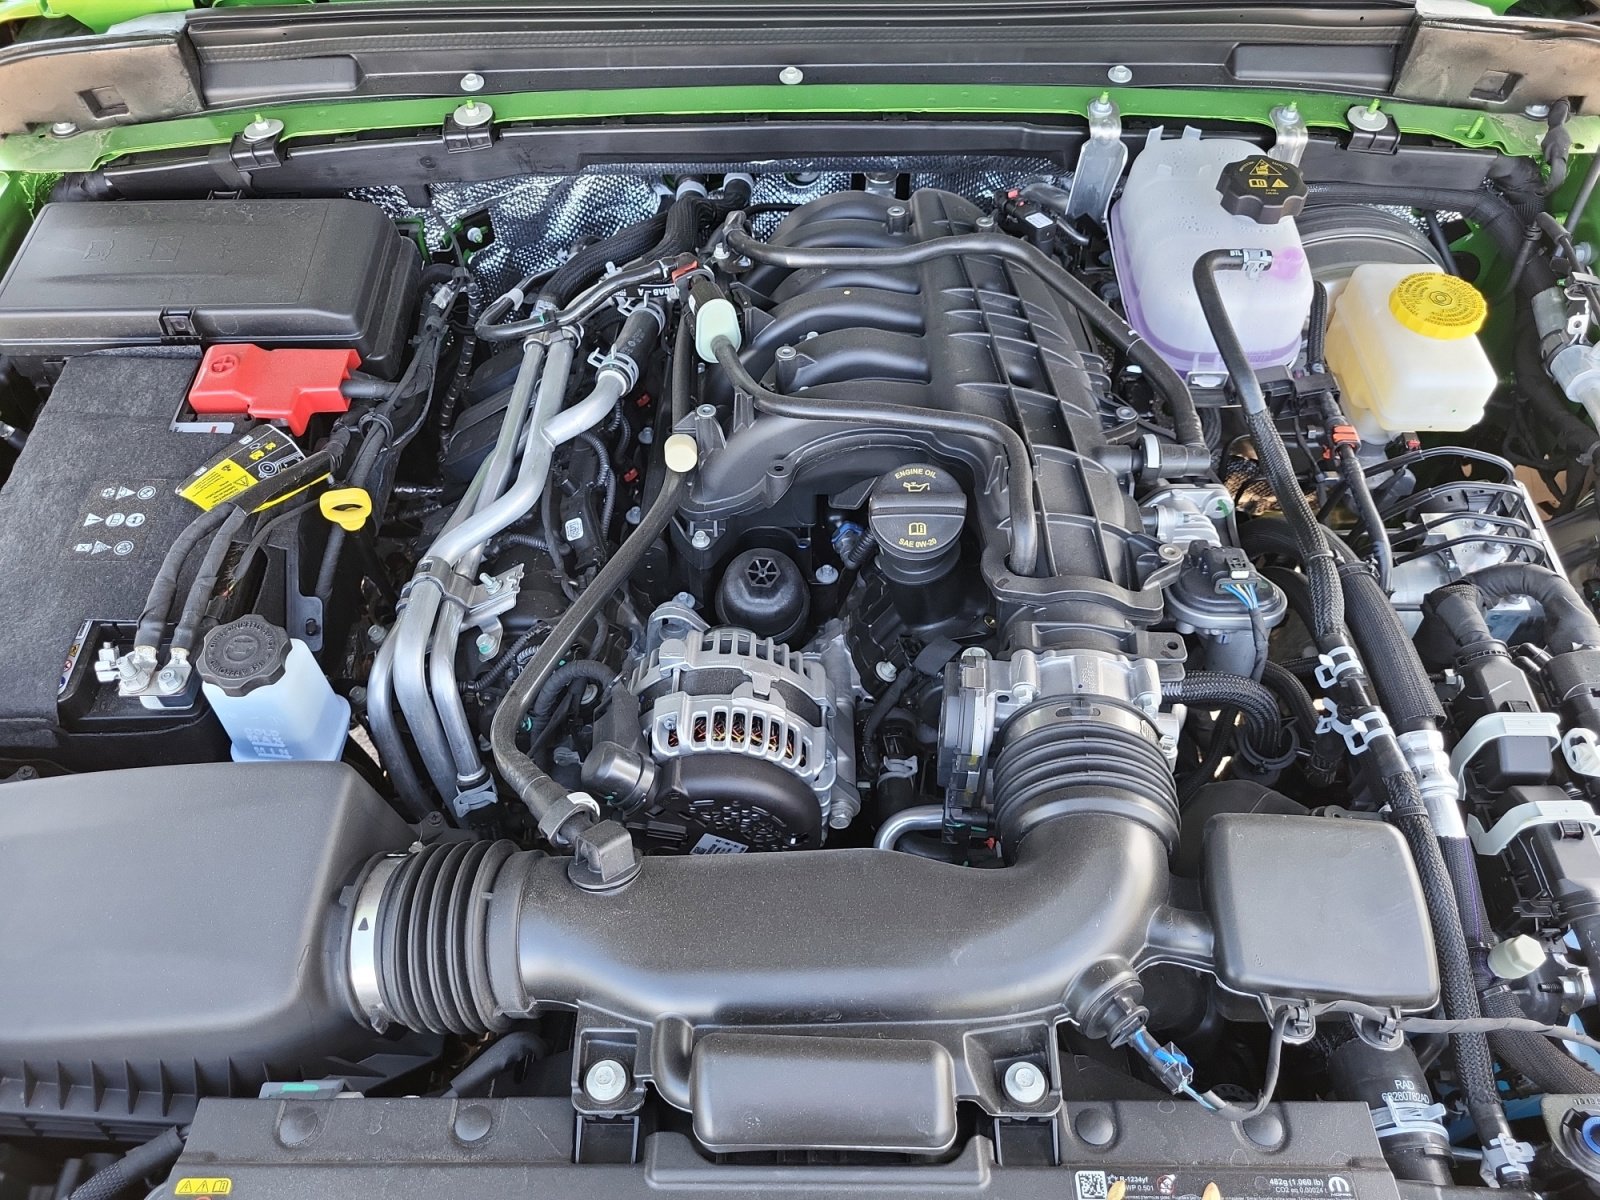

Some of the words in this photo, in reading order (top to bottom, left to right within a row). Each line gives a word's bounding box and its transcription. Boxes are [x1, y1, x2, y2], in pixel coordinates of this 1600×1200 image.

[894, 468, 924, 480] ENGINE
[925, 469, 937, 479] OIL
[898, 538, 914, 548] SAE
[915, 537, 937, 549] 0W-20
[209, 659, 249, 677] APPROVED
[246, 736, 284, 744] MAX
[253, 746, 290, 755] MIN
[1394, 1079, 1415, 1090] RAD
[1138, 1184, 1154, 1192] 0.501
[1269, 1178, 1288, 1188] 482g
[1275, 1186, 1290, 1194] CO2
